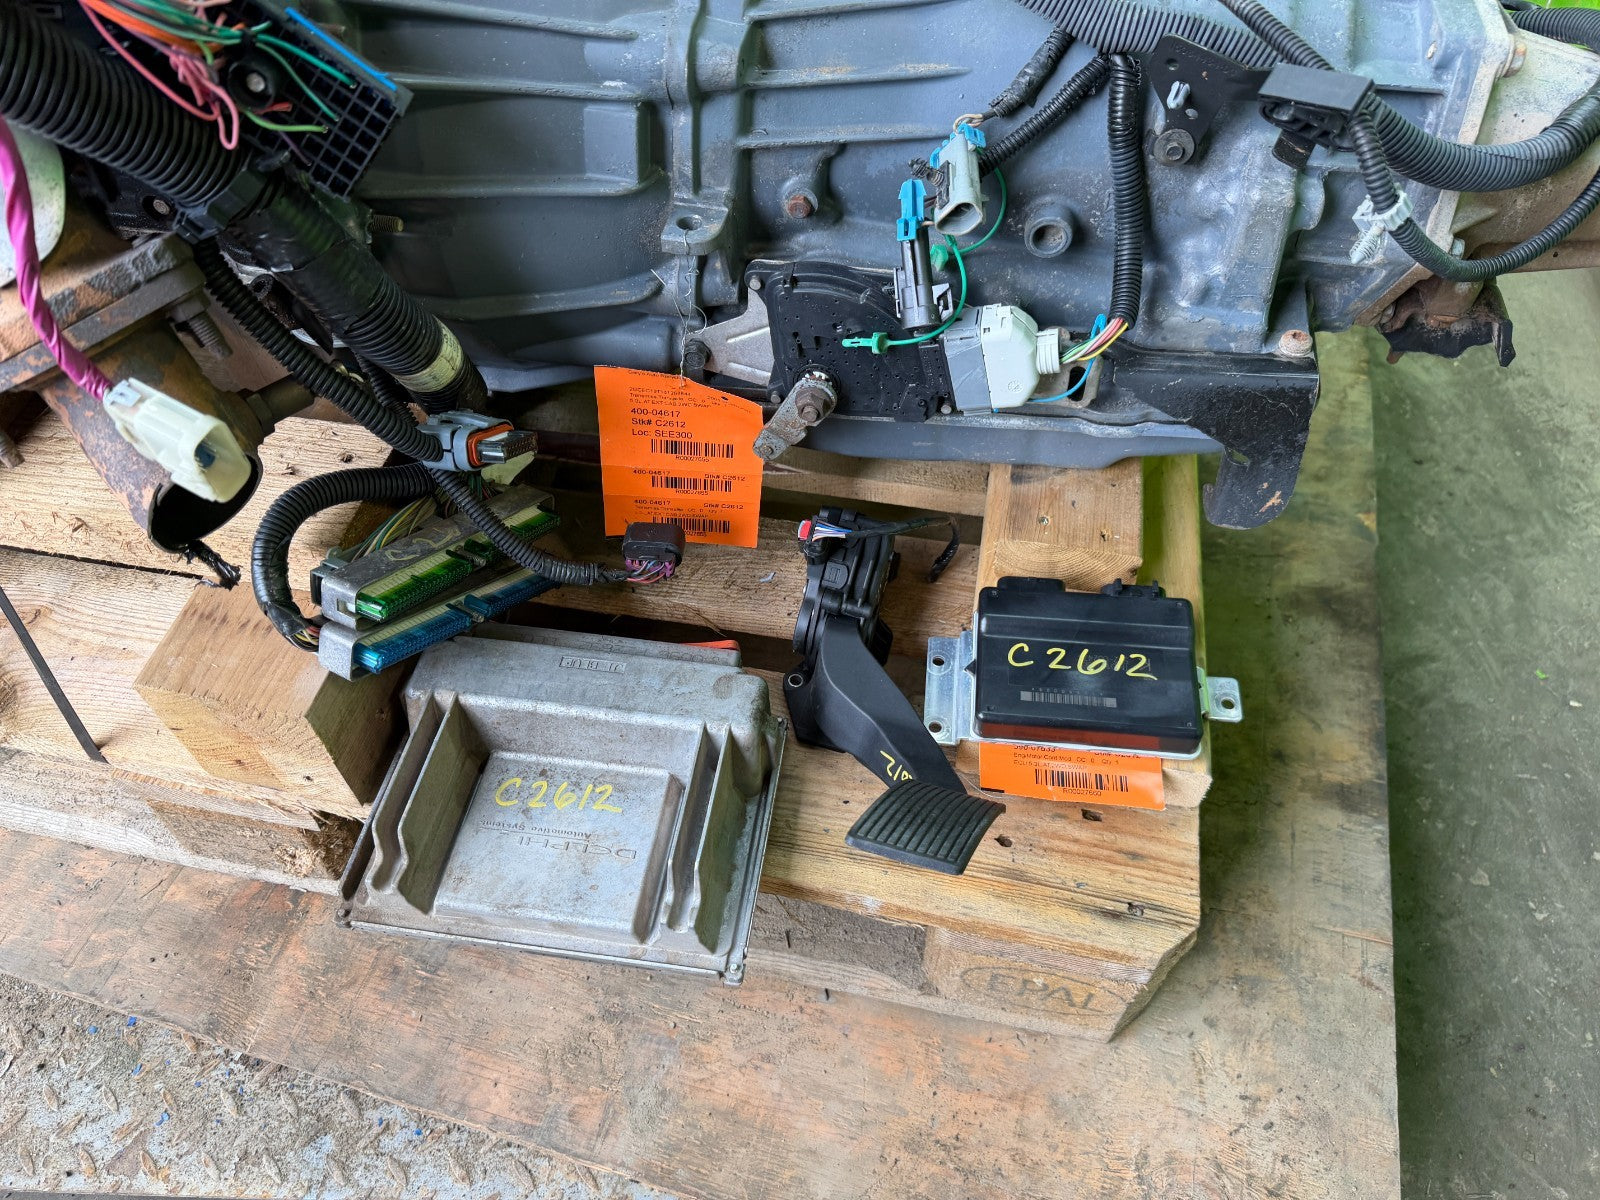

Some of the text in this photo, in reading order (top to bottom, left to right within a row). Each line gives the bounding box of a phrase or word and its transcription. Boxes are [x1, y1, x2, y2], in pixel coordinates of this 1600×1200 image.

[631, 407, 680, 418] 400-04617
[631, 417, 686, 428] Stk# C2612
[632, 428, 693, 439] Loc: SEE300
[494, 777, 622, 813] C2612
[530, 826, 592, 840] Automotive
